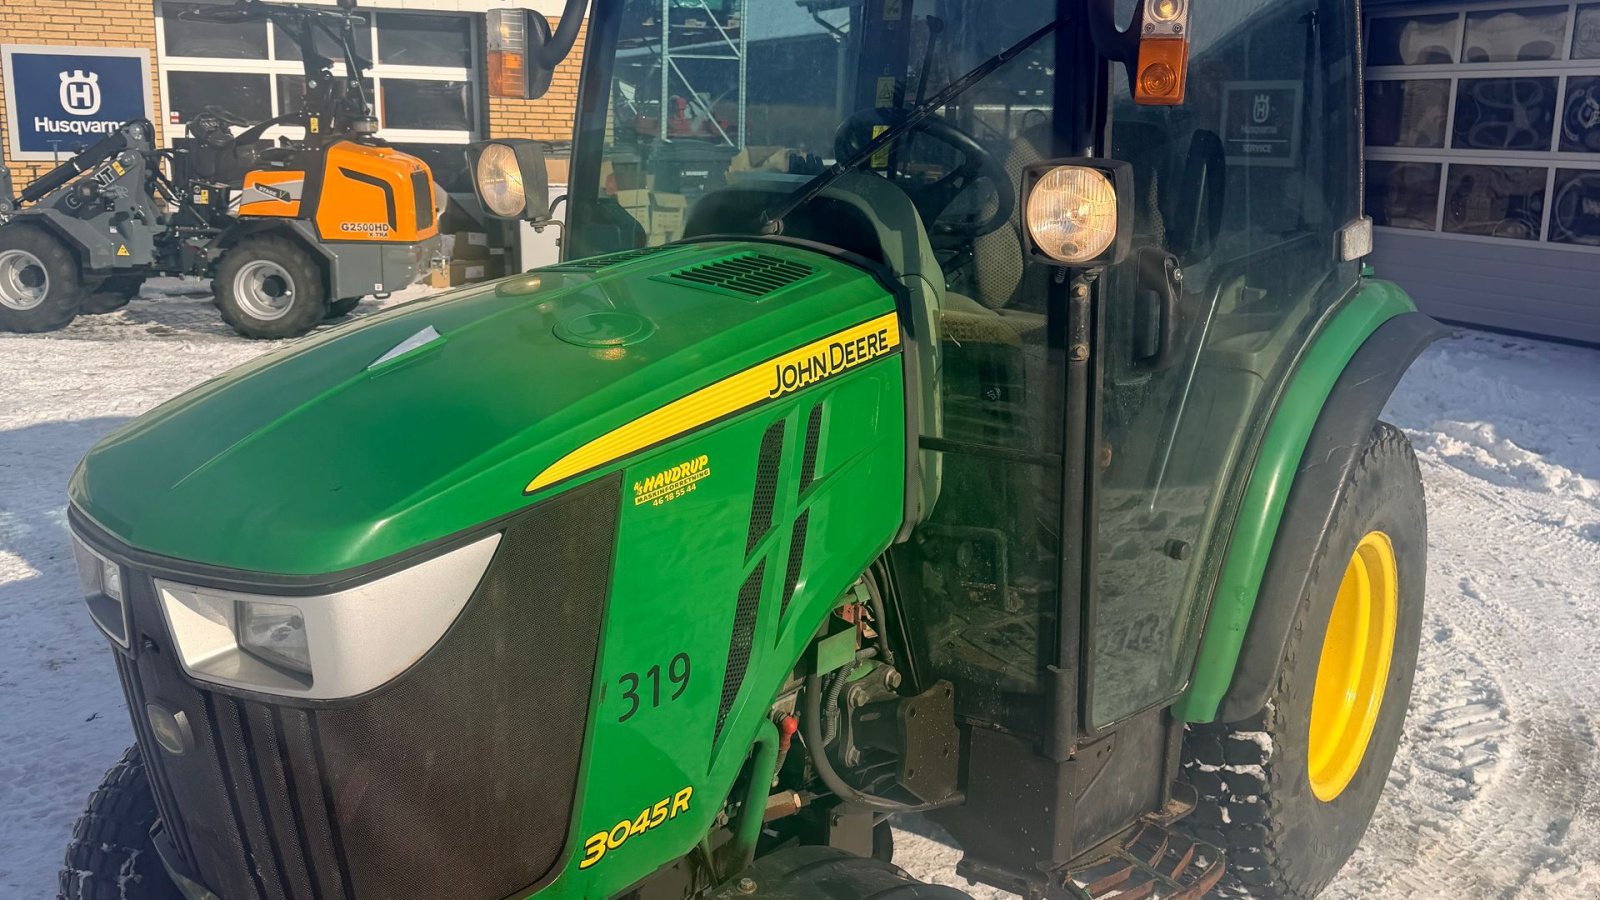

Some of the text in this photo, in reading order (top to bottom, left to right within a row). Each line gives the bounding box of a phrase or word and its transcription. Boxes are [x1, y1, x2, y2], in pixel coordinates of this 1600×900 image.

[34, 116, 127, 135] Husqvarn
[258, 186, 277, 197] STAGE
[341, 223, 389, 231] G2500HD
[769, 328, 889, 396] JOHN DEERE
[637, 469, 709, 504] MASKINFORRETNING
[643, 454, 709, 493] HAVDRUP
[653, 483, 697, 507] 46 18 55 44
[618, 652, 691, 723] 319
